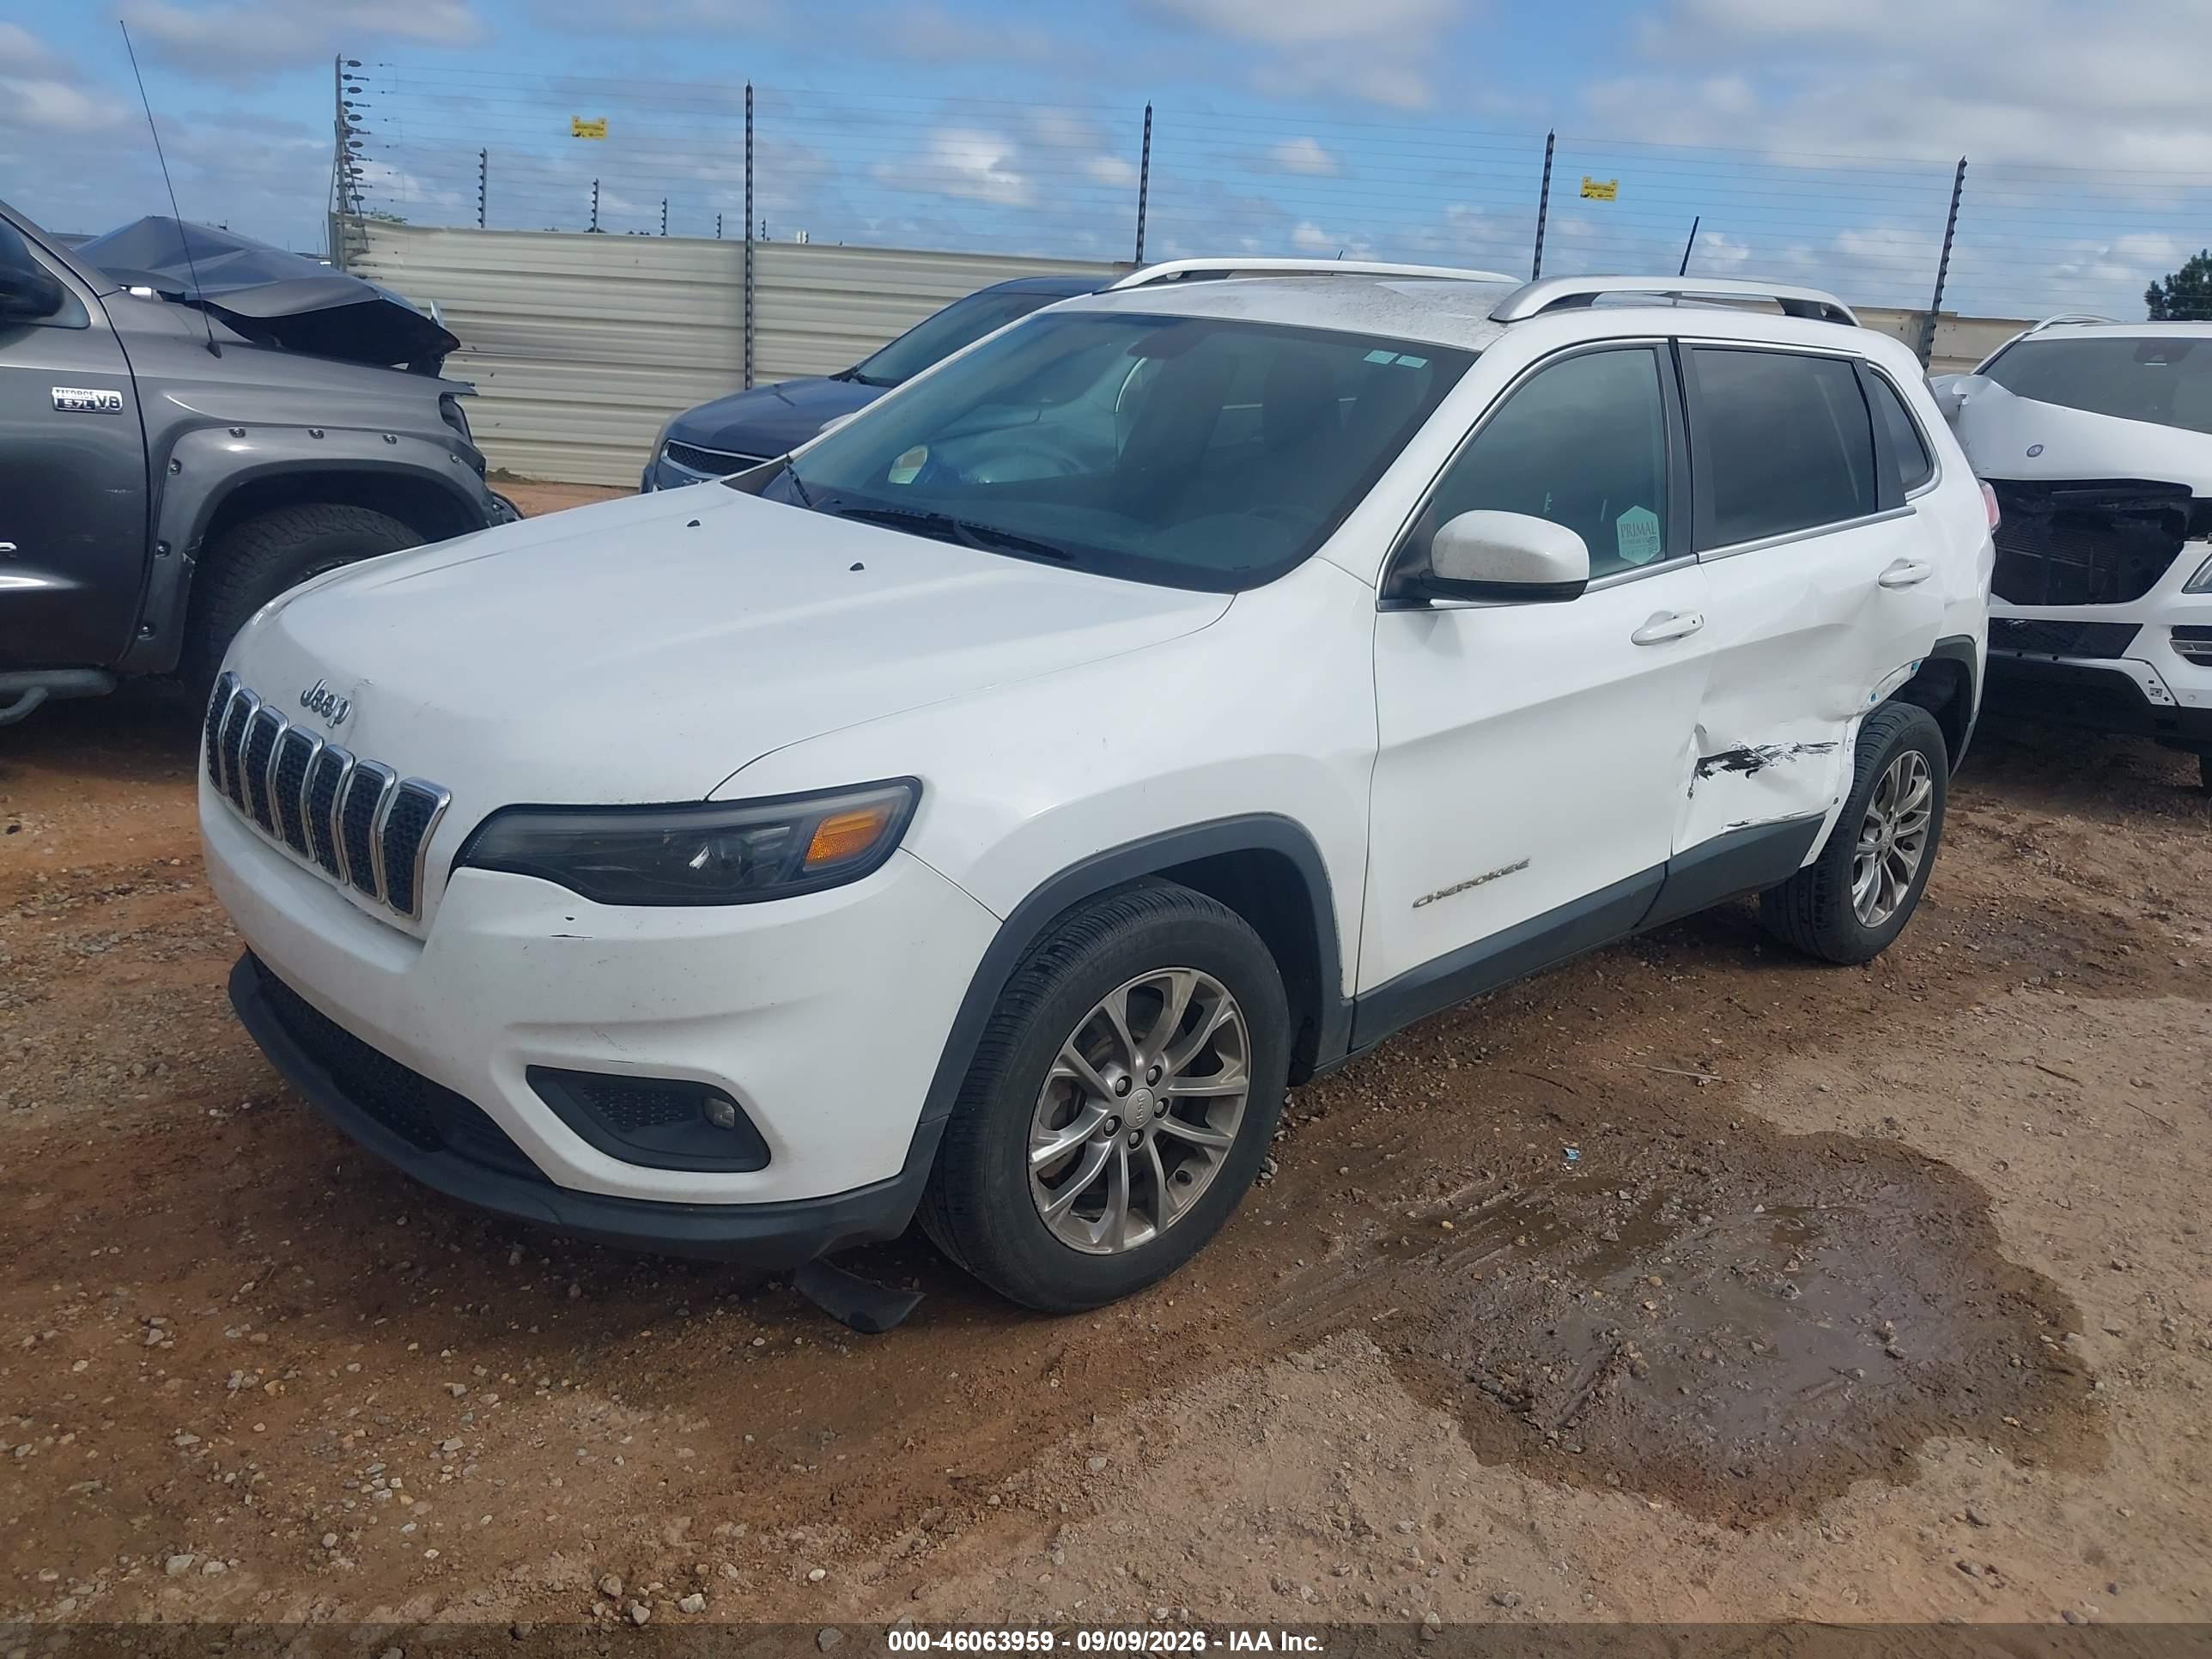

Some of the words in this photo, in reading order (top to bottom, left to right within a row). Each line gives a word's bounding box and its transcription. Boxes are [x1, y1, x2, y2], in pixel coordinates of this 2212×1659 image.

[96, 395, 121, 410] V8
[1620, 521, 1656, 538] PRIMAL
[301, 678, 352, 729] Jeep
